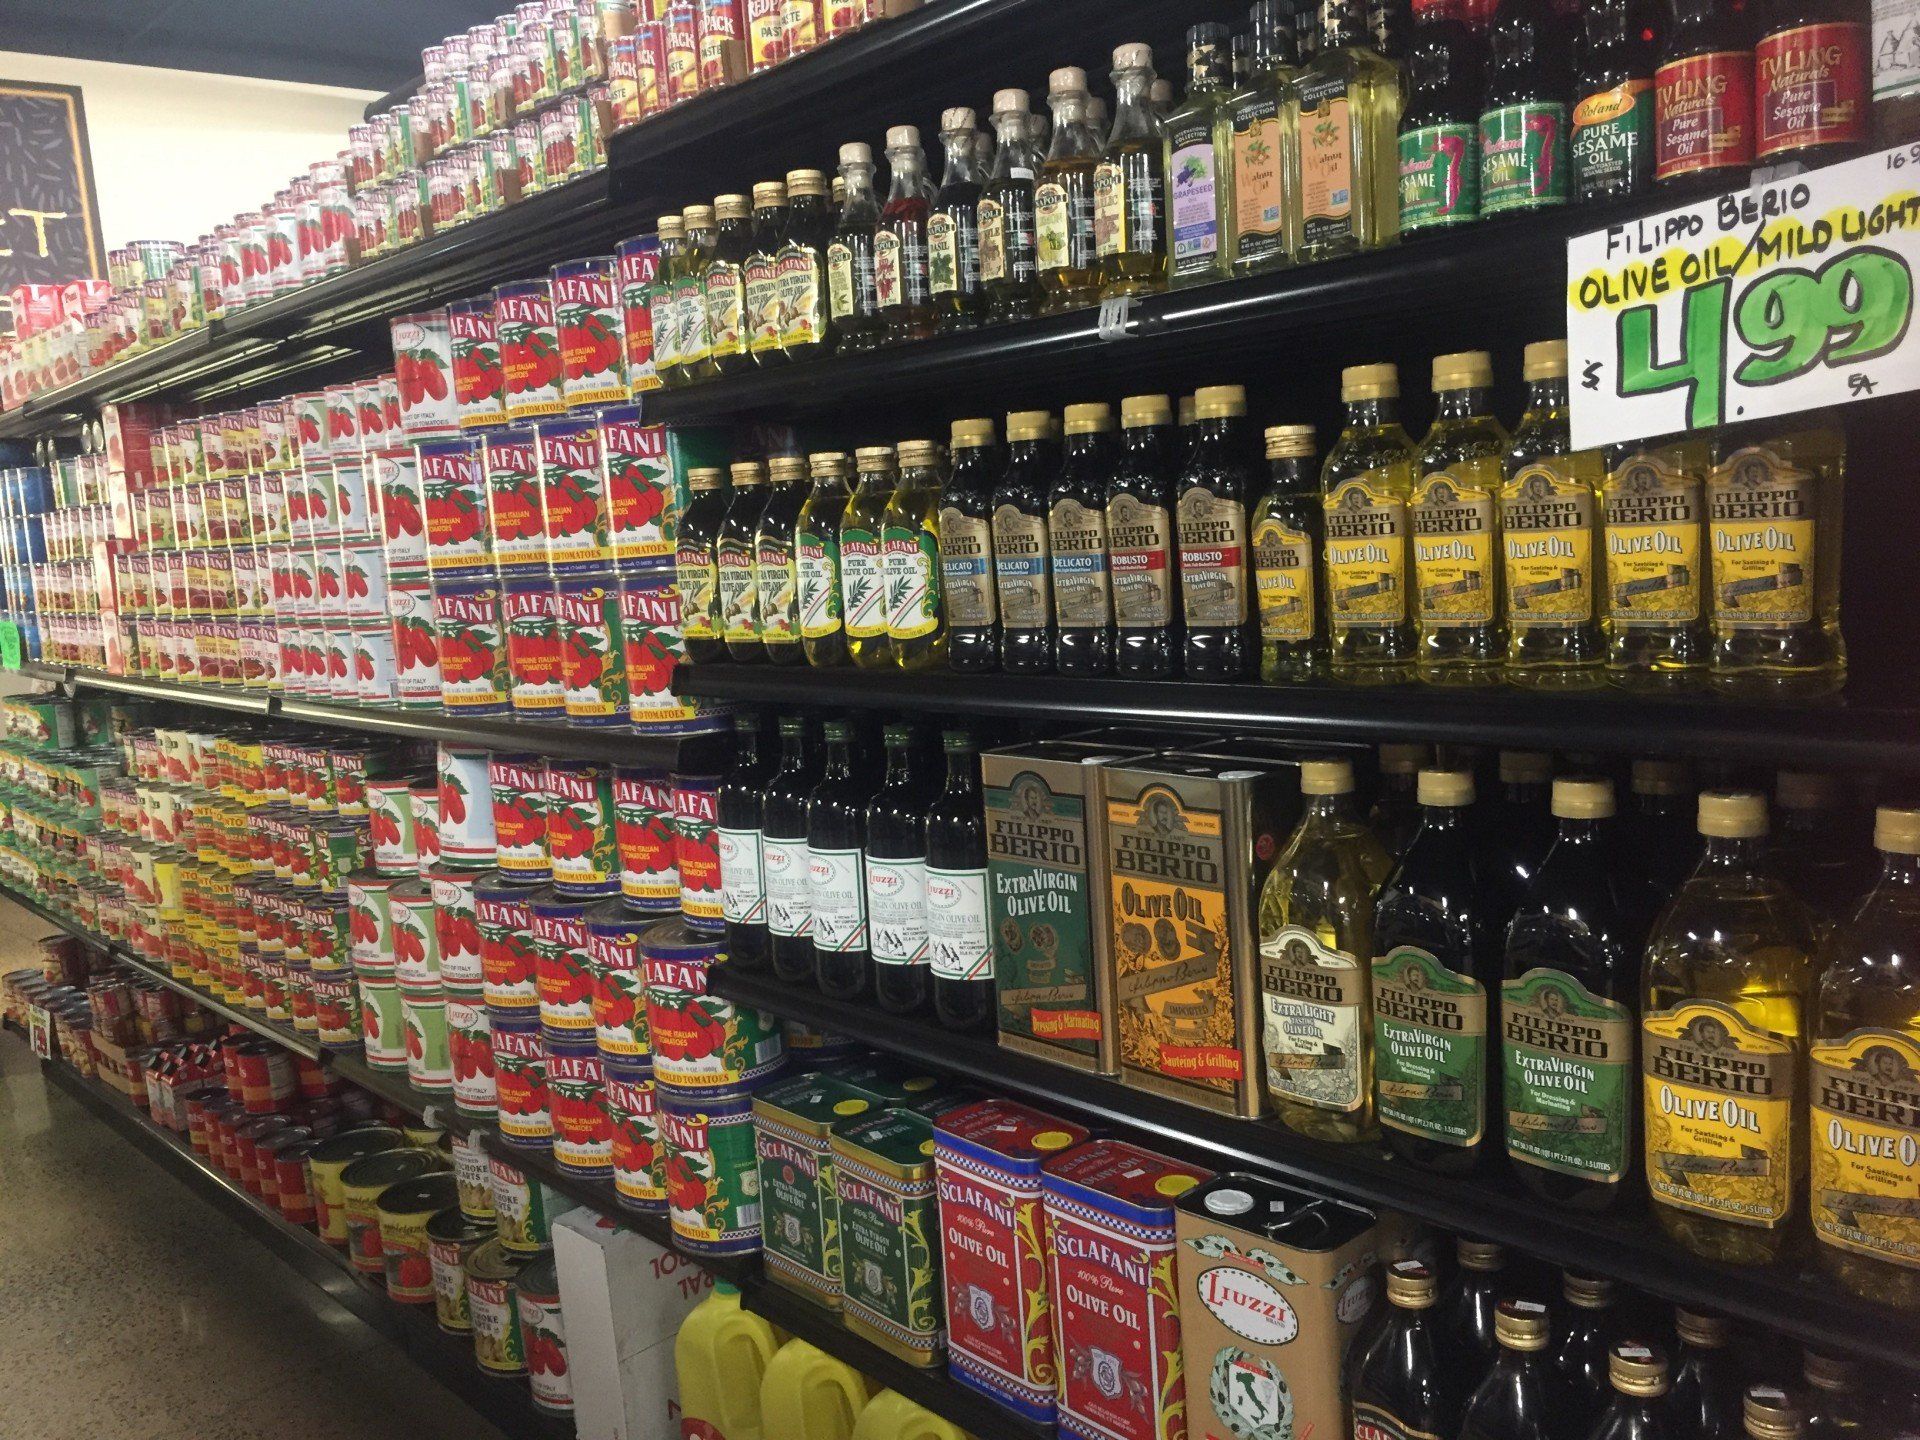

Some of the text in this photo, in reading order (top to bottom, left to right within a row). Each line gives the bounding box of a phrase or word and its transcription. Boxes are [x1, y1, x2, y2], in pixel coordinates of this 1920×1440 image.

[1303, 86, 1345, 101] COLLECTION
[1781, 89, 1811, 104] Pure
[1236, 106, 1275, 122] COLLECTION
[1581, 99, 1622, 118] Roland
[1773, 102, 1821, 121] Sesame
[1583, 123, 1620, 140] PURE
[1672, 116, 1699, 132] Pure
[1787, 115, 1805, 129] Oil
[1572, 132, 1639, 158] SESAME
[1666, 129, 1707, 147] Sesame
[1589, 151, 1613, 165] OIL
[1677, 142, 1694, 155] Oil
[1483, 153, 1527, 176] SESAME
[1492, 168, 1511, 184] OIL
[1174, 184, 1213, 200] GRAPESEED
[1717, 183, 1811, 232] BERIO
[1579, 258, 1669, 309] OLIVE
[583, 389, 626, 403] TOMATOES
[526, 402, 566, 415] TOMATOES
[470, 413, 507, 425] TOMATOES
[1716, 488, 1799, 503] FILIPPO
[1414, 507, 1477, 520] FILIPPO
[1507, 501, 1577, 515] FILIPPO
[1606, 505, 1690, 524] BERIO
[1712, 500, 1804, 520] BERIO
[1329, 512, 1390, 525] FILIPPO
[1414, 517, 1482, 533] BERIO
[1504, 511, 1582, 529] BERIO
[1327, 521, 1395, 538] BERIO
[1508, 534, 1575, 560] OLIVE OIL
[1609, 528, 1683, 555] OLIVE OIL
[1715, 526, 1796, 553] OLIVE OIL
[623, 544, 668, 556] TOMATOES
[1182, 551, 1223, 562] ROBUSTO
[1330, 541, 1390, 565] OLIVE OIL
[1417, 538, 1476, 562] OLIVE OIL
[448, 554, 489, 566] TOMATOES
[848, 559, 867, 568] PURE
[888, 557, 908, 567] PURE
[1053, 557, 1093, 569] DELICATO
[1112, 554, 1149, 566] ROBUSTO
[687, 568, 710, 579] VIRGIN
[730, 570, 753, 581] VIRGIN
[766, 569, 790, 580] VIRGIN
[863, 566, 876, 576] OIL
[904, 566, 918, 575] OIL
[1279, 572, 1295, 589] OIL
[994, 819, 1075, 845] FILIPPO
[990, 832, 1081, 866] BERIO
[1121, 833, 1211, 861] FILIPPO
[512, 858, 549, 868] TOMATOES
[1115, 848, 1218, 885] BERIO
[564, 872, 598, 881] TOMATOES
[910, 900, 923, 910] OIL
[1007, 890, 1072, 917] OLIVE OIL
[1121, 882, 1206, 925] OLIVE OIL
[1267, 964, 1337, 987] FILIPPO
[1264, 973, 1343, 1002] BERIO
[1380, 987, 1457, 1014] FILIPPO
[1271, 996, 1335, 1025] EXTRA LIGHT
[1376, 996, 1463, 1031] BERIO
[1063, 1013, 1100, 1034] Marinating
[1283, 1021, 1324, 1040] OLIVE OIL
[1512, 1011, 1602, 1041] FILIPPO
[1506, 1021, 1608, 1059] BERIO
[1391, 1040, 1446, 1064] OLIVE OIL
[1659, 1045, 1767, 1076] FILIPPO
[1205, 1054, 1240, 1073] Grilling
[685, 1072, 730, 1085] TOMATOES
[1524, 1069, 1588, 1094] OLIVE OIL
[1653, 1055, 1773, 1096] BERIO
[1660, 1085, 1761, 1134] OLIVE OIL
[1680, 1124, 1693, 1134] For
[1827, 1118, 1896, 1159] OLIVE
[1693, 1134, 1724, 1149] Grilling
[759, 1141, 817, 1180] SCLAFANI
[1850, 1161, 1865, 1172] For
[1864, 1173, 1899, 1188] Grilling
[775, 1189, 805, 1210] OLIVE OIL
[839, 1179, 900, 1223] SCLAFANI
[940, 1180, 1014, 1227] SCLAFANI
[975, 1217, 995, 1238] Pure
[855, 1232, 888, 1257] OLIVE OIL
[949, 1227, 1009, 1269] OLIVE OIL
[1056, 1232, 1149, 1287] SCLAFANI
[1076, 1269, 1124, 1297] 100% Pure
[1208, 1272, 1287, 1322] LIUZZI
[1066, 1284, 1141, 1331] OLIVE OIL
